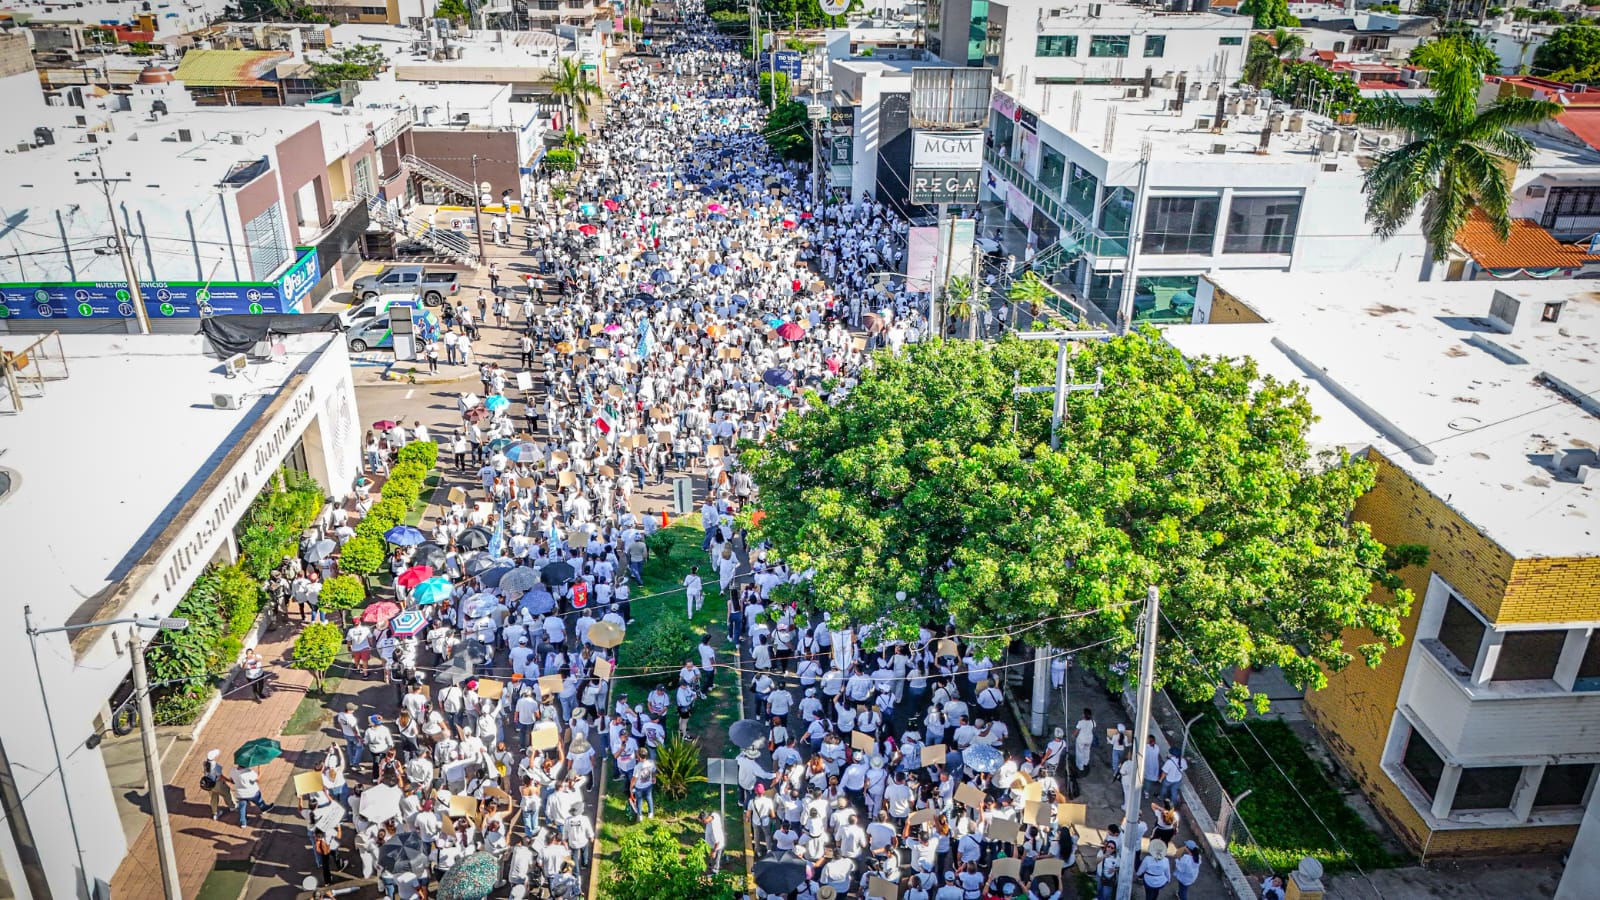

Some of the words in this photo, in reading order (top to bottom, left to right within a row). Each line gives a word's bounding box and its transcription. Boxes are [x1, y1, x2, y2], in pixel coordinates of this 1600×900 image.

[924, 138, 973, 153] MGM
[915, 177, 977, 193] REGA
[163, 471, 249, 592] ultrasonido
